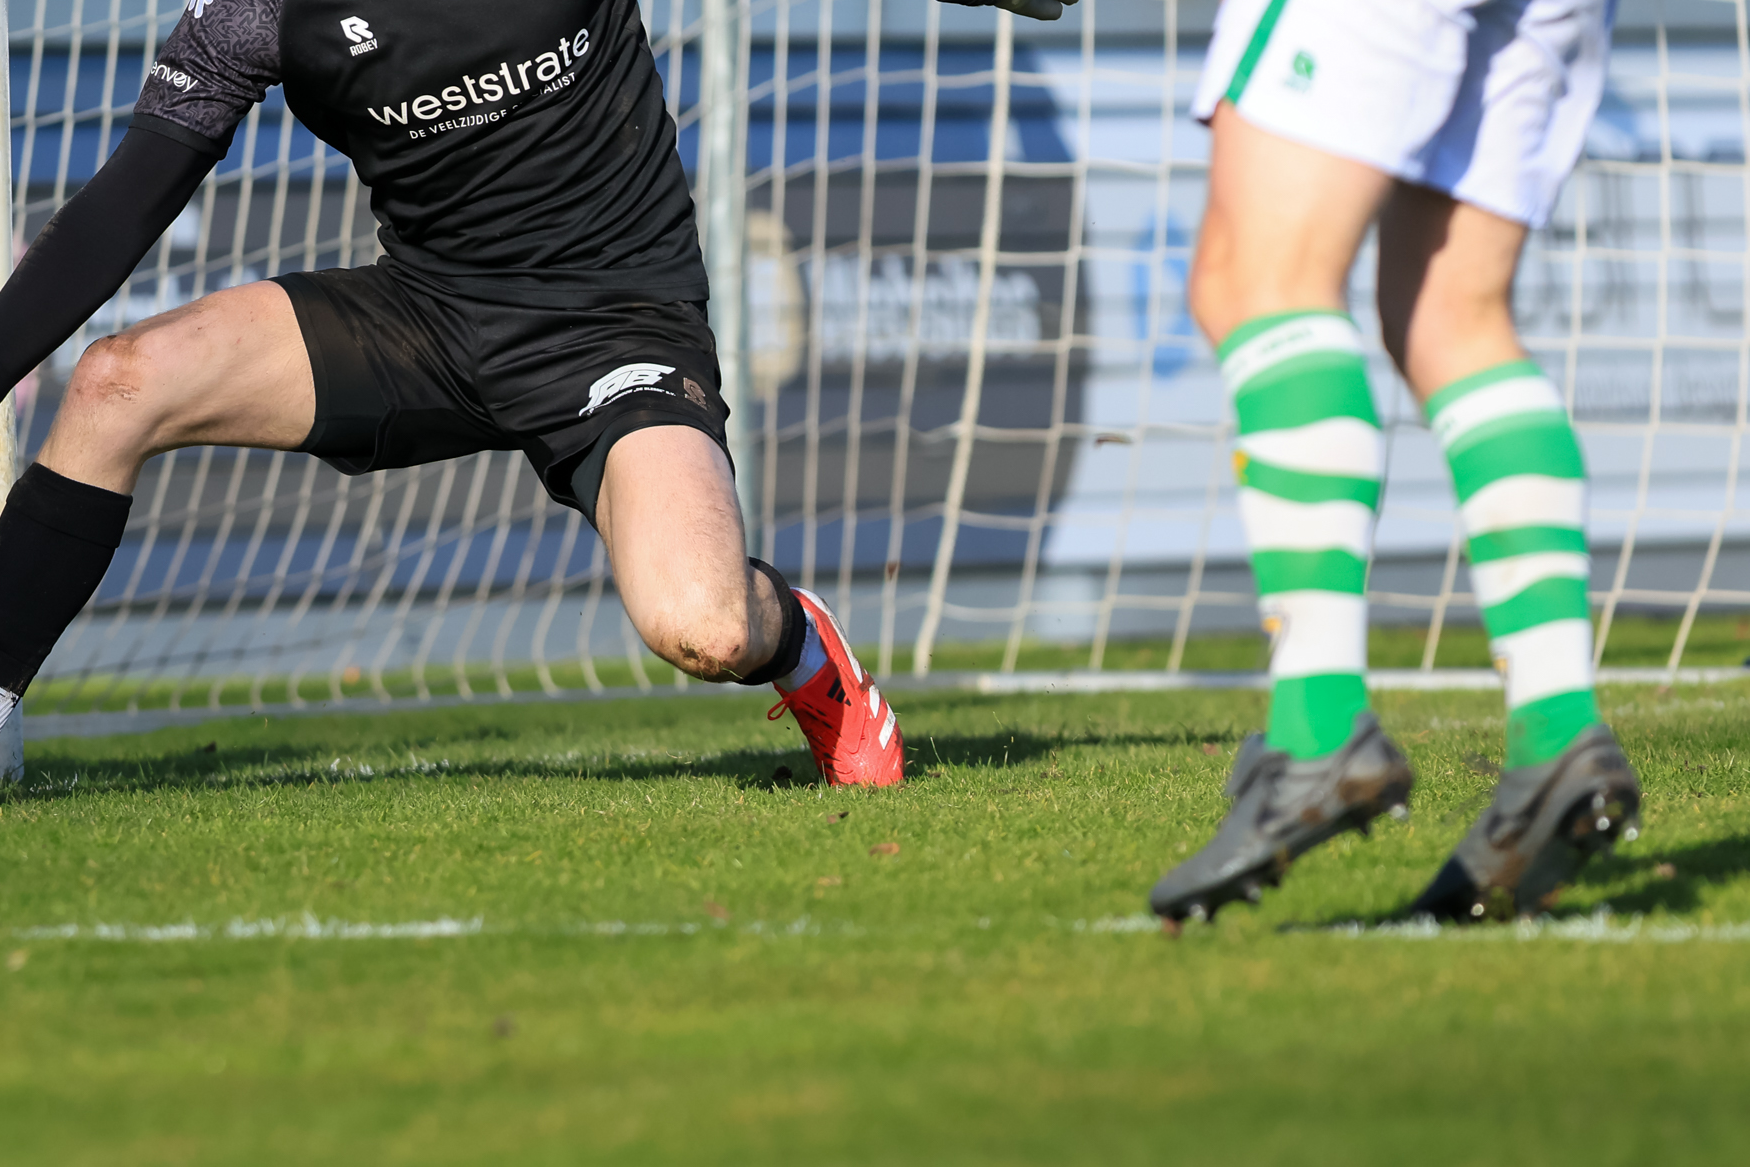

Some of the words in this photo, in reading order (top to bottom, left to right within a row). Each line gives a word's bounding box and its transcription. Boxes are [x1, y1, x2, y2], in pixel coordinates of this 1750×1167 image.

[349, 37, 379, 57] ROBEY
[366, 27, 591, 126] weststrate
[409, 129, 427, 140] DE
